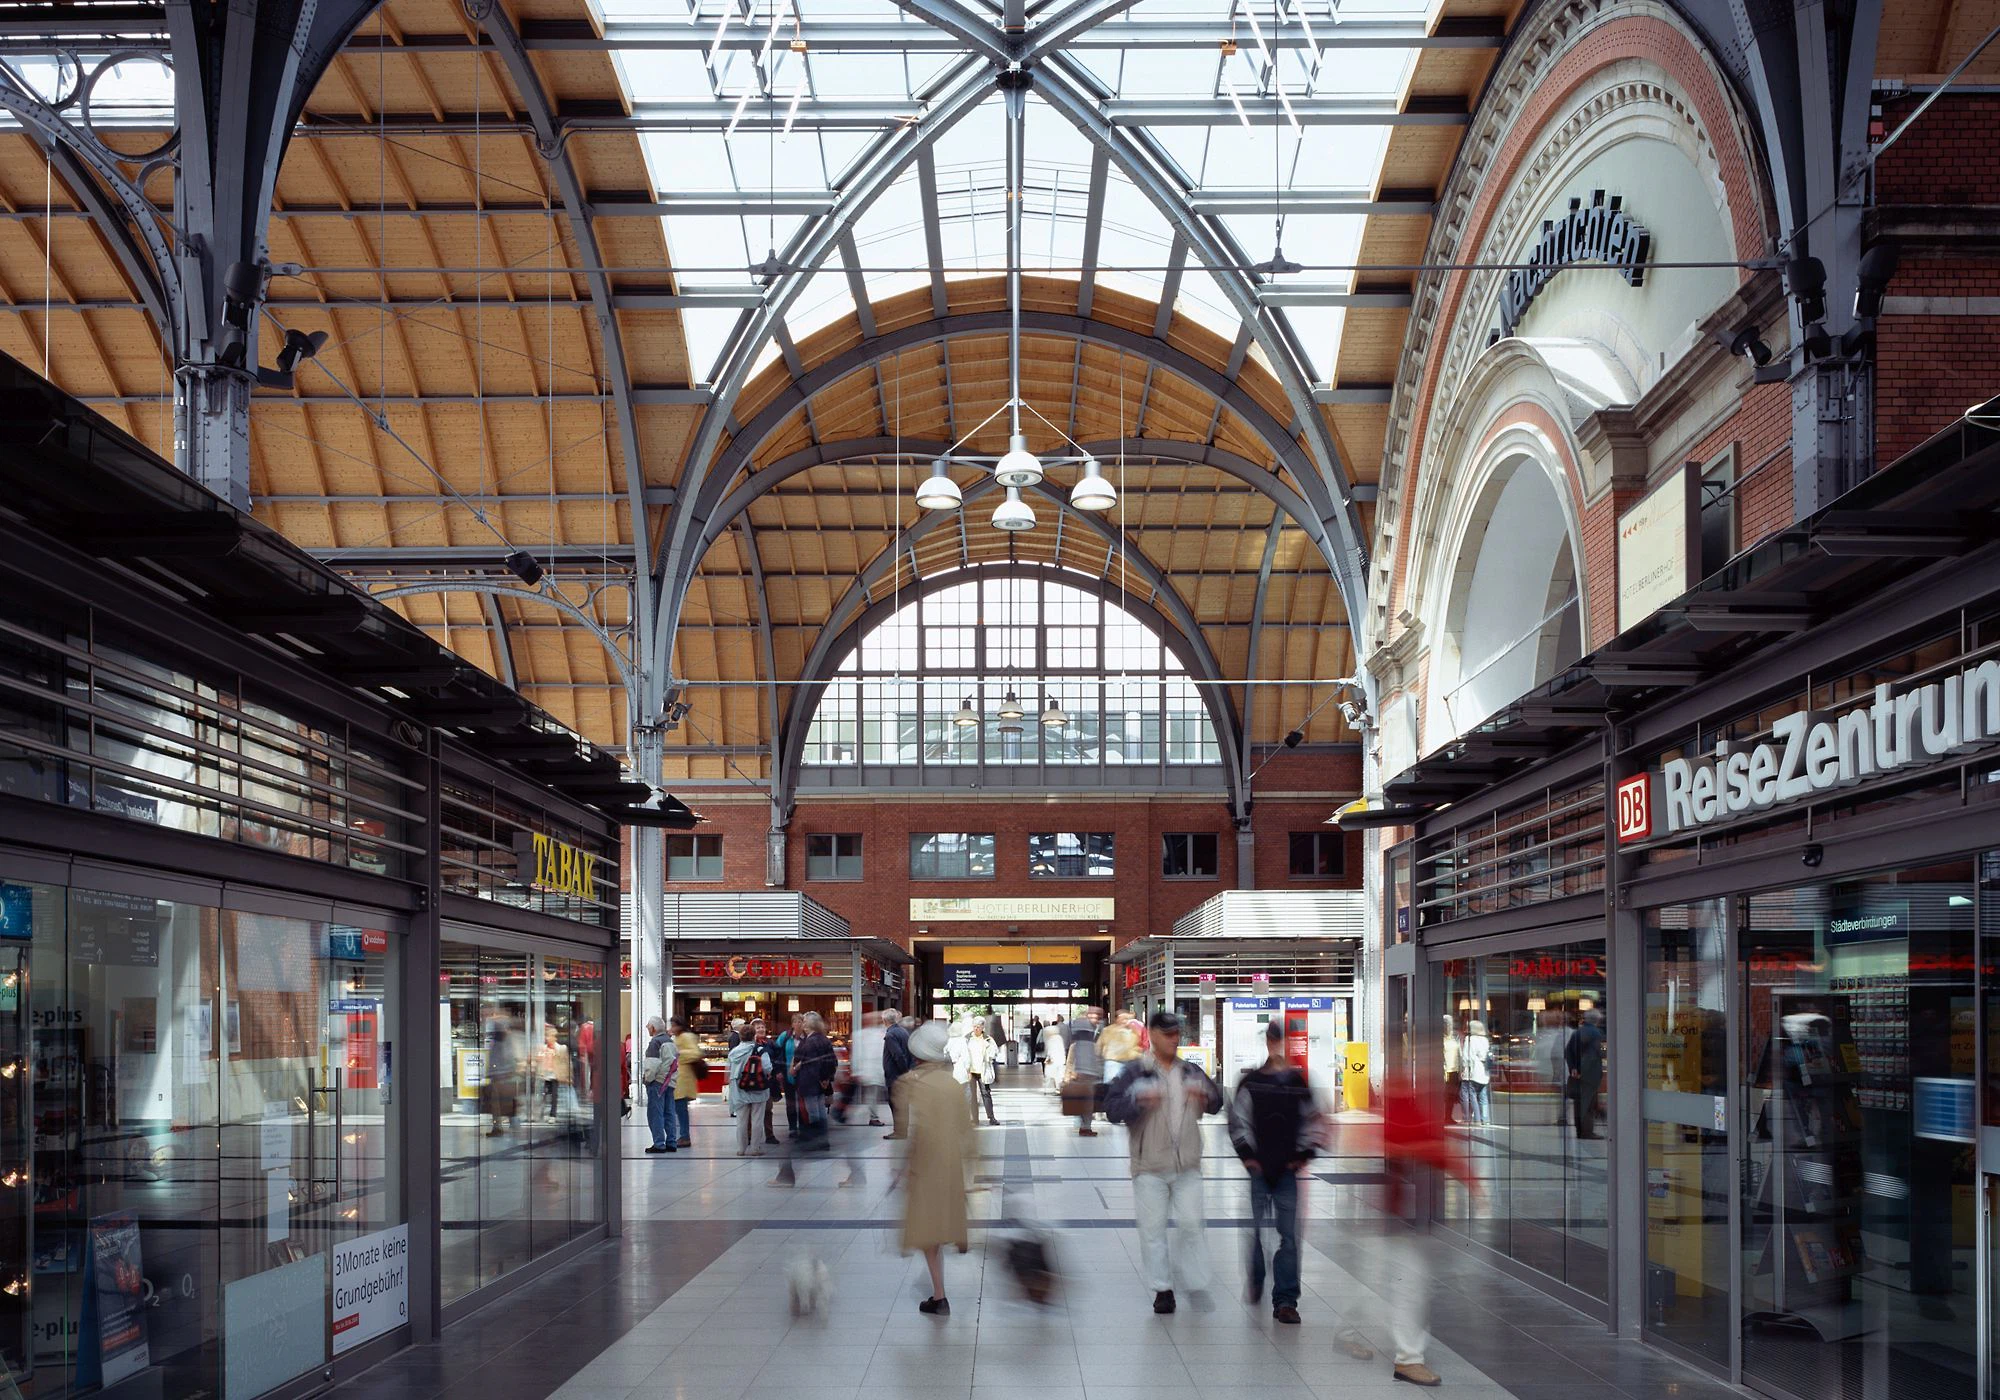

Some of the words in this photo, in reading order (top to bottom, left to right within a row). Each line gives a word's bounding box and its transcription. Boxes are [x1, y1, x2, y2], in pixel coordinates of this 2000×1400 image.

[1487, 190, 1650, 348] Nachrichten
[1620, 785, 1645, 834] DB
[533, 832, 597, 901] TABAK
[976, 903, 1101, 914] HOTELBERLINERHOF
[1830, 915, 1897, 933] Städteverbindungen
[746, 959, 823, 977] CROBAG
[342, 1245, 380, 1274] Monate
[382, 1236, 407, 1260] keine
[335, 1266, 403, 1309] Grundgebühr!
